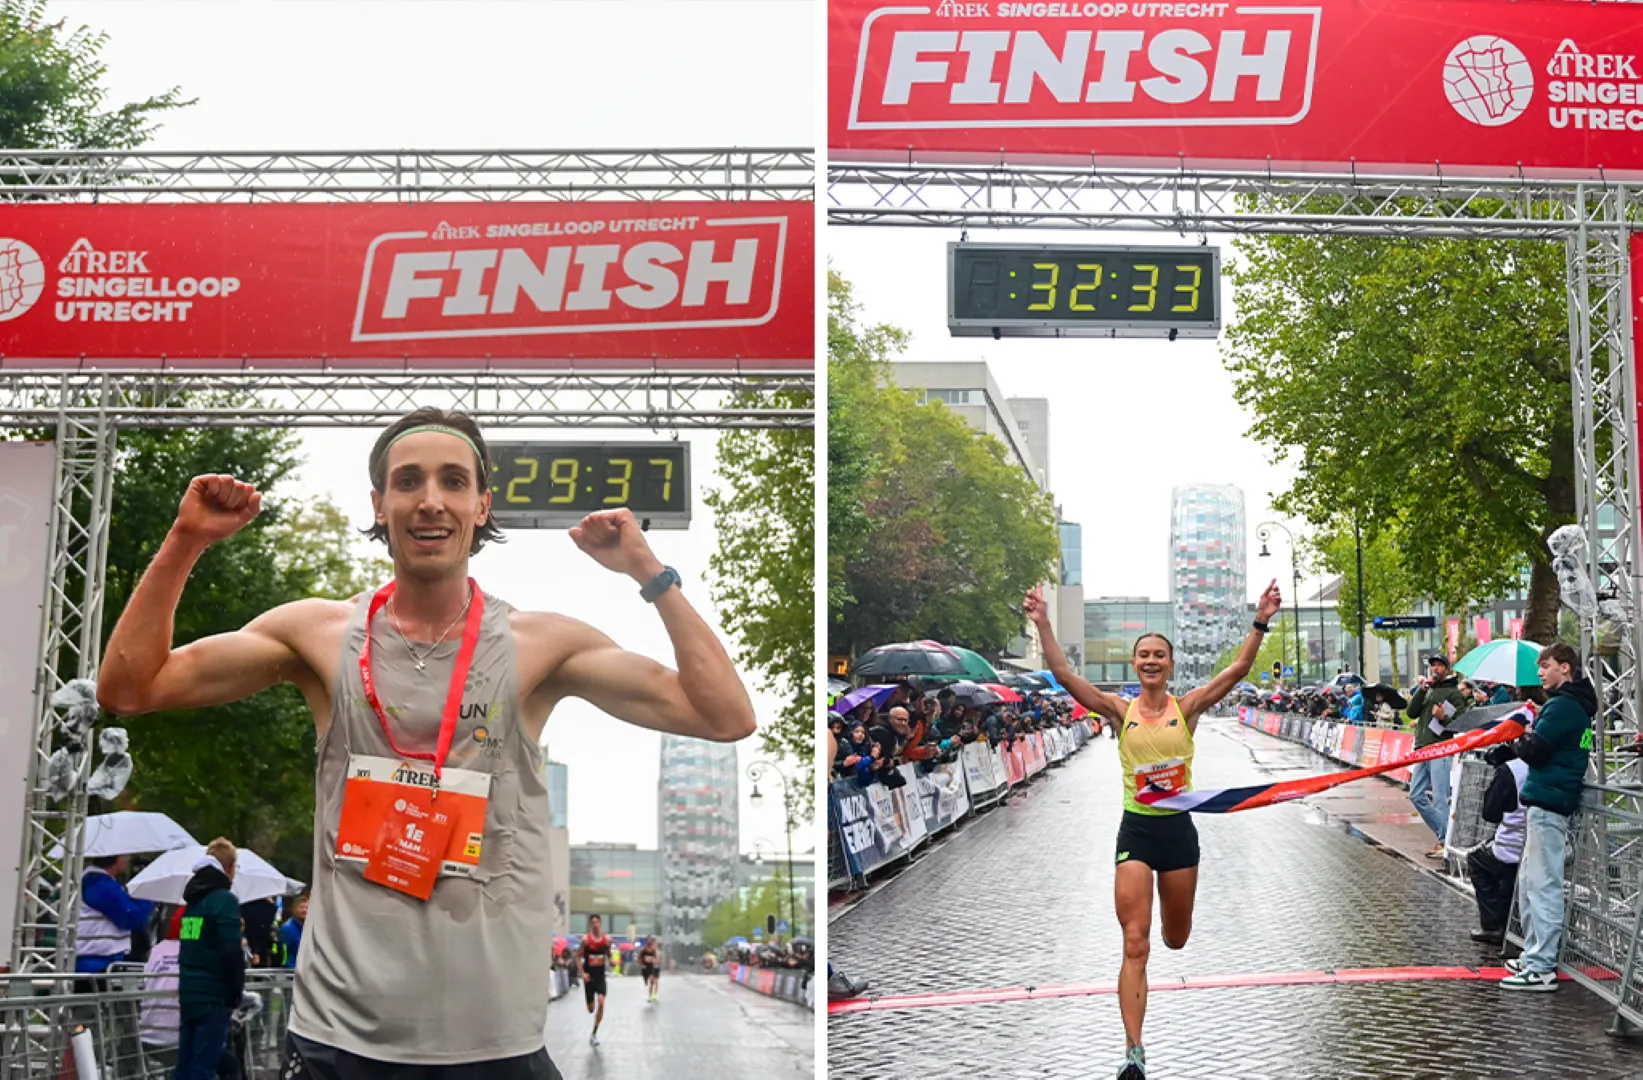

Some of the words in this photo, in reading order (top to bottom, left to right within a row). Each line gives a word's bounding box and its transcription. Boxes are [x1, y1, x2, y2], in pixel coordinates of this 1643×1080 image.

[936, 0, 990, 17] TREK
[996, 3, 1128, 18] SINGELLOOP
[1132, 2, 1229, 17] UTRECHT
[881, 28, 1292, 105] FINISH
[1548, 45, 1641, 79] TREK
[433, 224, 480, 240] TREK
[485, 220, 605, 238] SINGELLOOP
[609, 217, 699, 232] UTRECHT
[60, 244, 150, 274] TREK
[56, 276, 241, 298] SINGELLOOP
[381, 238, 760, 319] FINISH
[55, 300, 193, 322] UTRECHT
